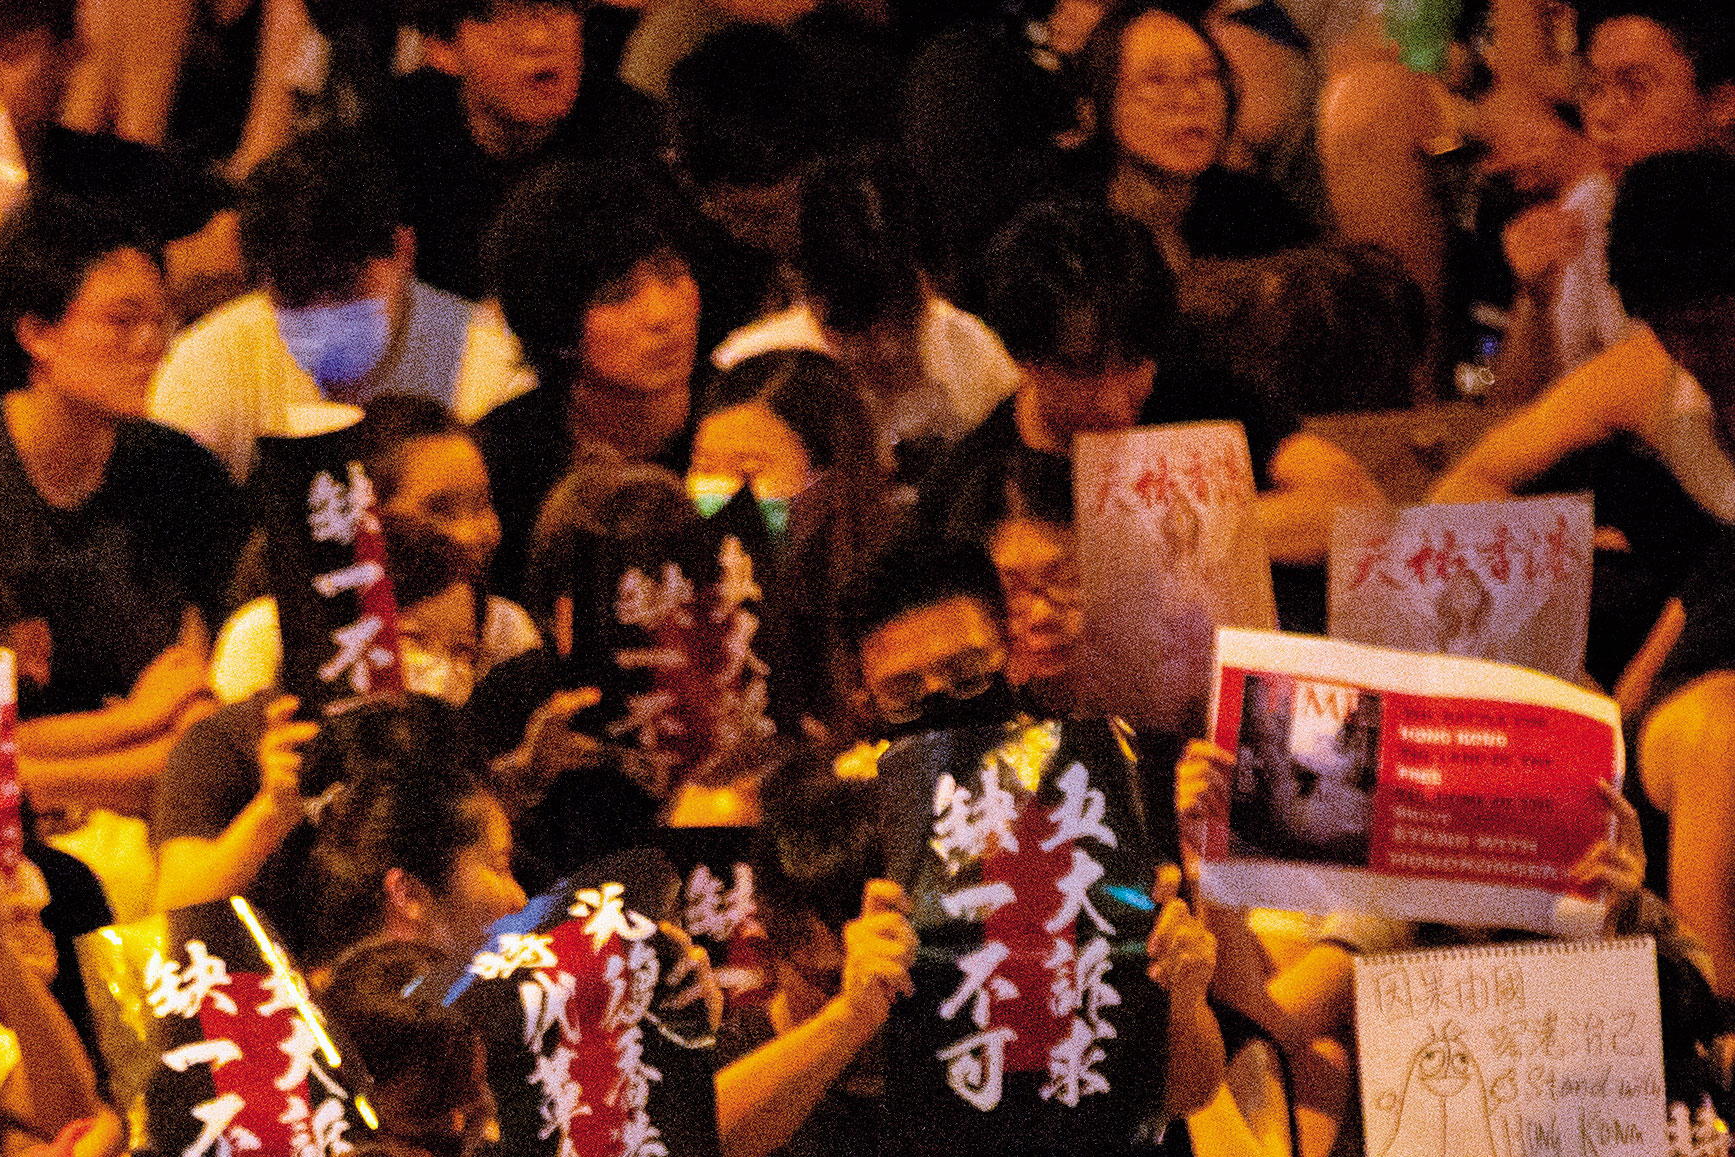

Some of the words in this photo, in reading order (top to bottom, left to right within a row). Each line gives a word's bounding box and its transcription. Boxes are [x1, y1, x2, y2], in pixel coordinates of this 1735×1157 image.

[309, 461, 393, 712] 缺一不
[931, 759, 1019, 1111] 缺一不可
[1040, 763, 1122, 1108] 五大訴求
